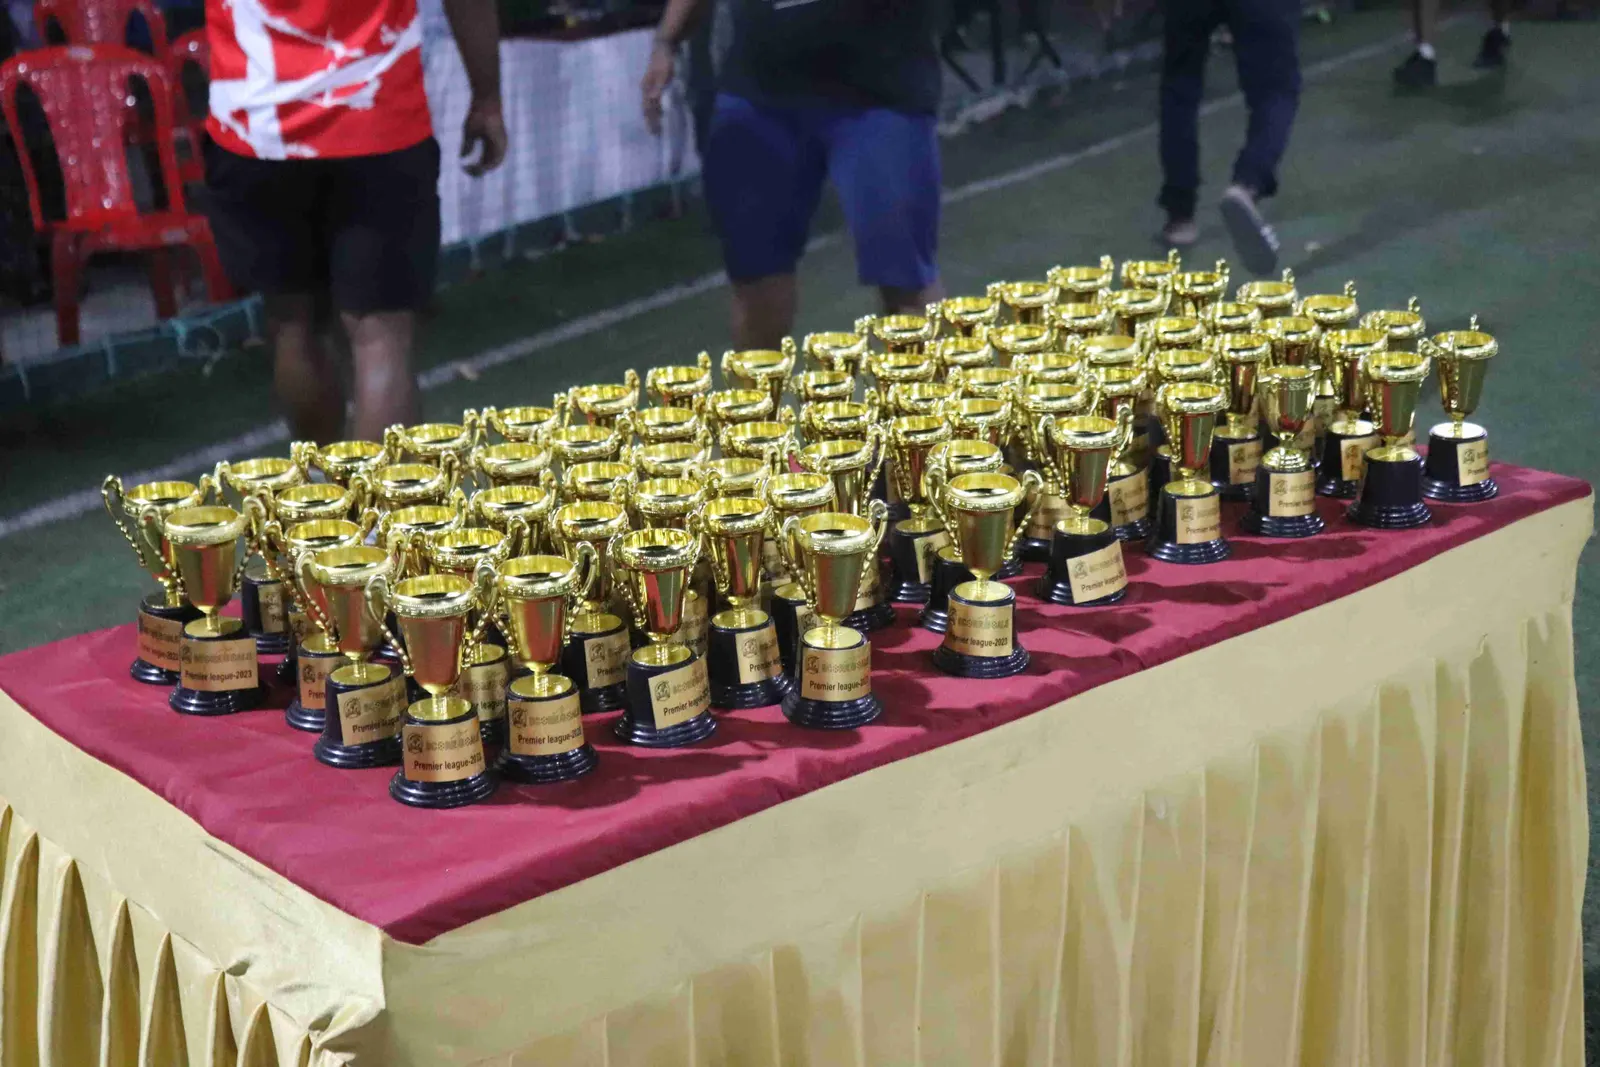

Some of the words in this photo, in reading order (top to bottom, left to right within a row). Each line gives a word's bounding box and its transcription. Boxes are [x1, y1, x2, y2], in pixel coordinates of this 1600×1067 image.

[970, 637, 1008, 648] league-2023
[184, 669, 207, 682] Premier
[209, 669, 253, 683] league-2023
[809, 680, 836, 691] Premier
[663, 700, 688, 717] Premier
[518, 733, 545, 745] Premier
[413, 761, 443, 772] Premier
